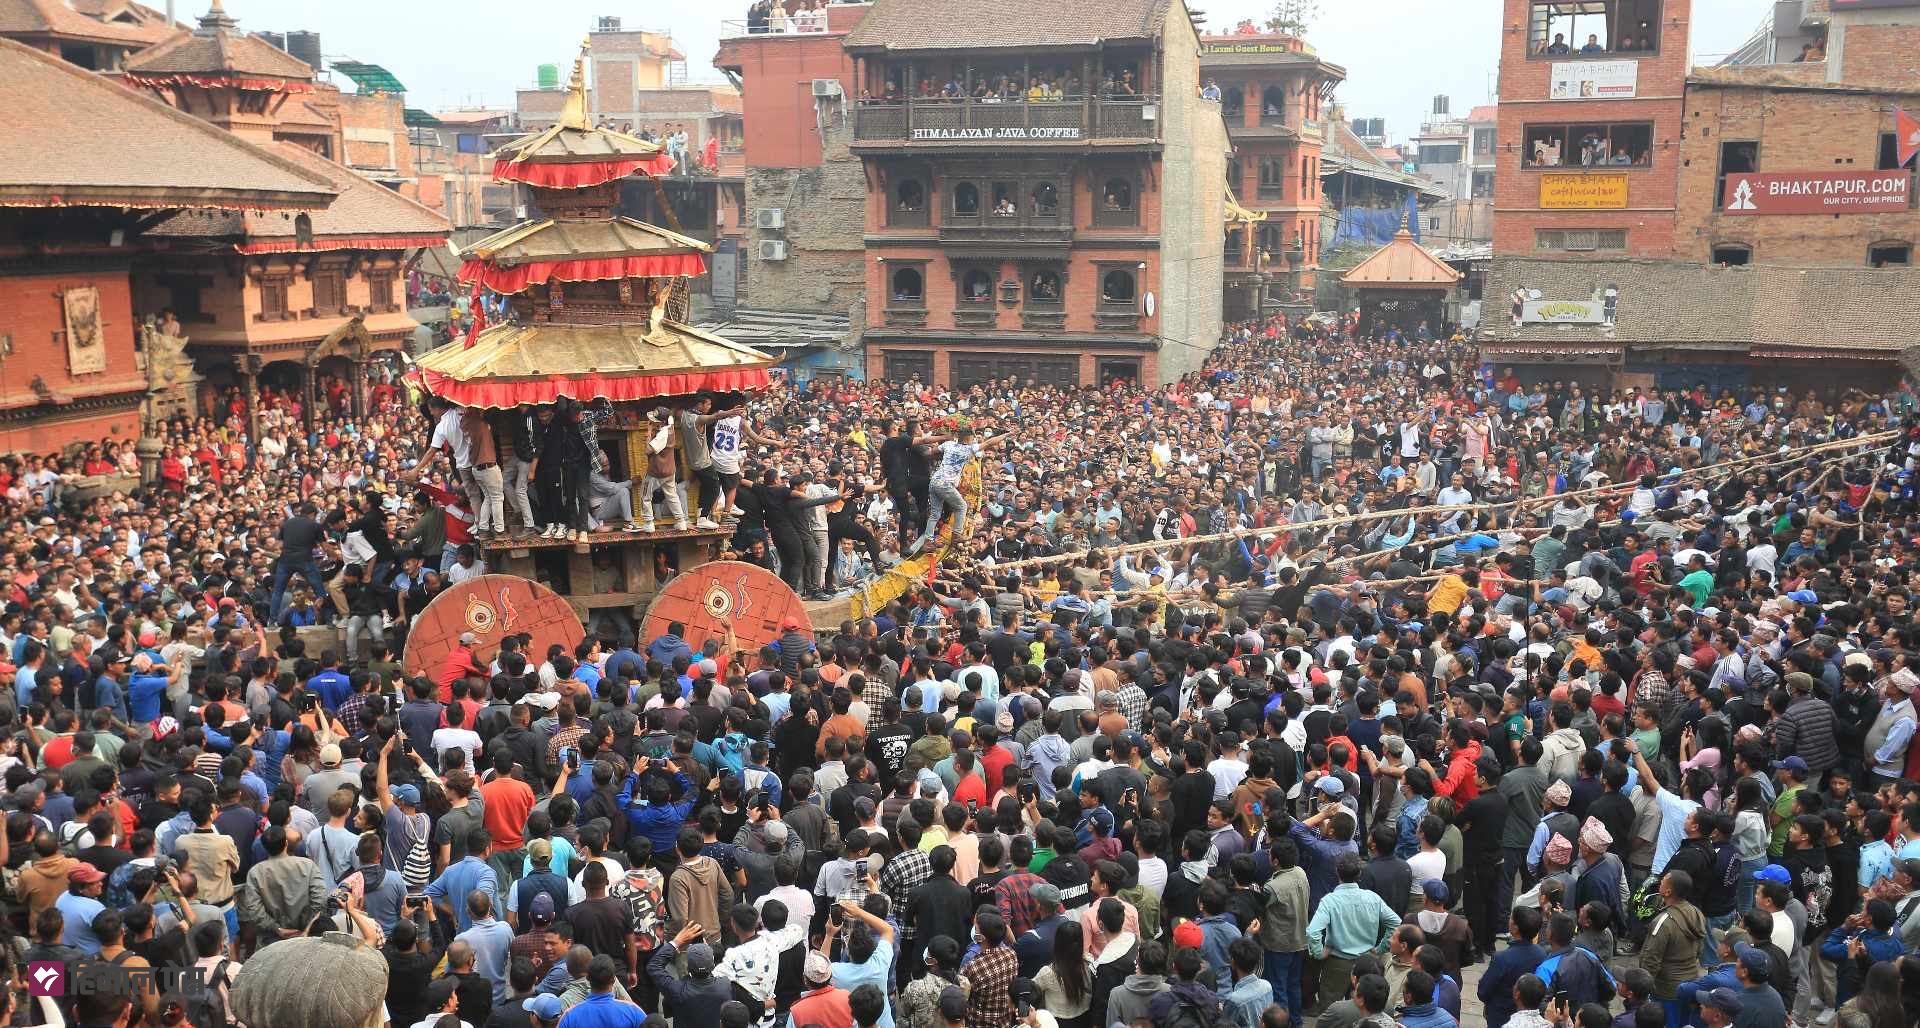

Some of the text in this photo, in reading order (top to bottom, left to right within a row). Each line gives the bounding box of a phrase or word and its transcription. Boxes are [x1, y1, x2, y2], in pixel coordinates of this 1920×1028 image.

[1210, 45, 1234, 53] Laxmi
[1260, 44, 1283, 53] House
[914, 128, 1079, 139] HIMALAYAN JAVA COFFEE
[1769, 178, 1906, 195] BHAKTAPUR.COM
[1824, 197, 1839, 205] OUR
[1863, 196, 1879, 204] OUR
[1882, 195, 1905, 203] PRIDE
[715, 432, 735, 452] 23
